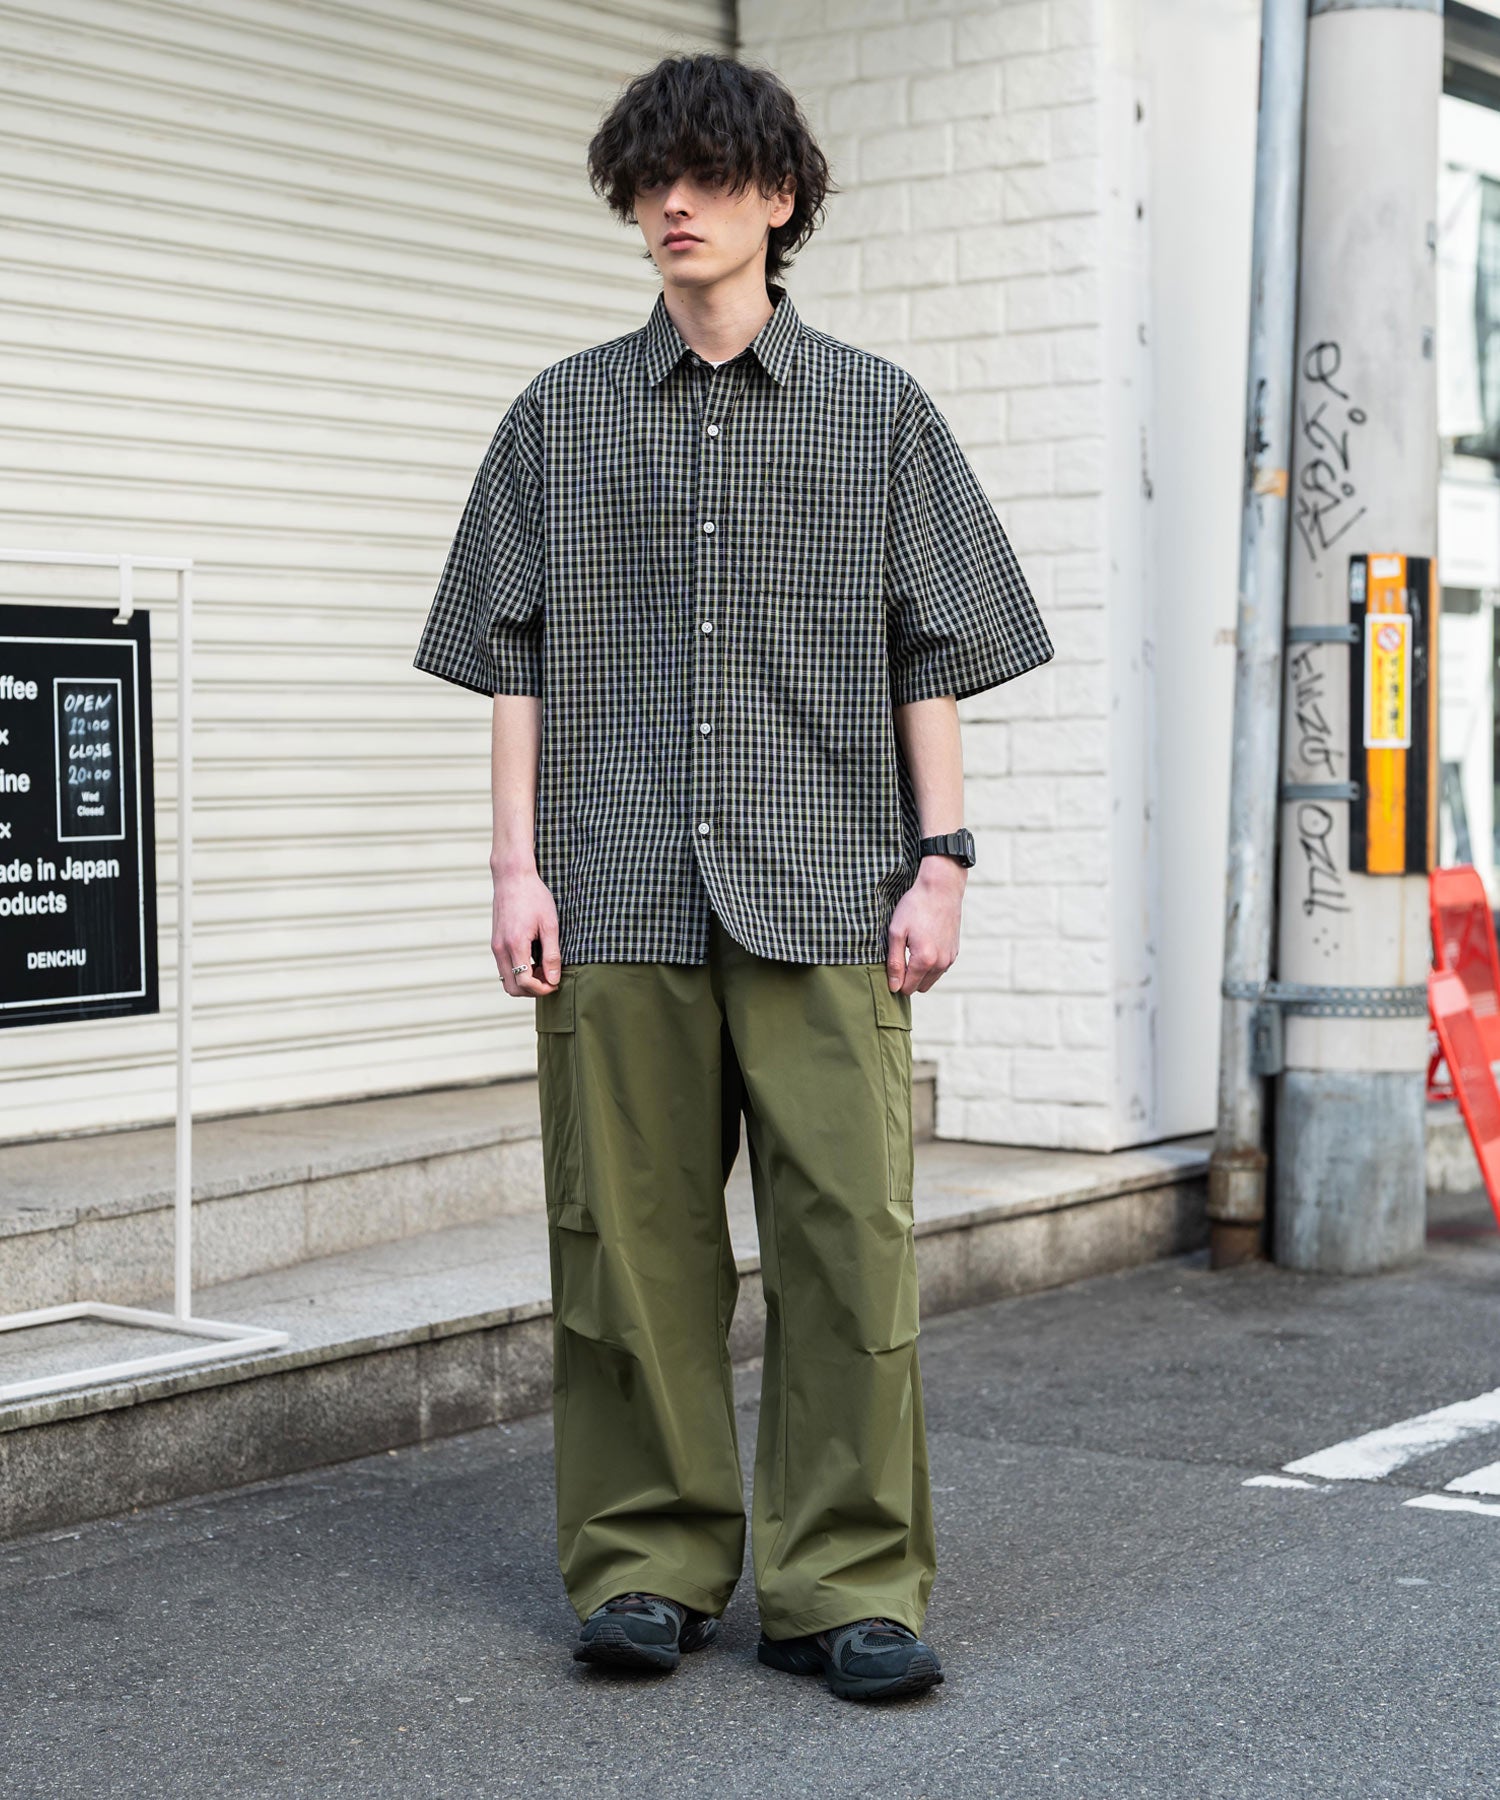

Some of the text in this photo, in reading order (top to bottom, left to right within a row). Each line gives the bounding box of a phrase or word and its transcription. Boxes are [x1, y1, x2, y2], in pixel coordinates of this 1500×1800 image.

[0, 675, 38, 700] ffee
[64, 694, 111, 712] OPEN
[69, 717, 109, 735] 12:00
[69, 743, 111, 760] CLOSE
[0, 769, 30, 792] ine
[69, 765, 111, 785] 20:00
[77, 805, 104, 816] Closed
[37, 858, 55, 881] in
[60, 857, 119, 884] Japan
[0, 891, 67, 916] oducts
[28, 949, 86, 969] DENCHU
